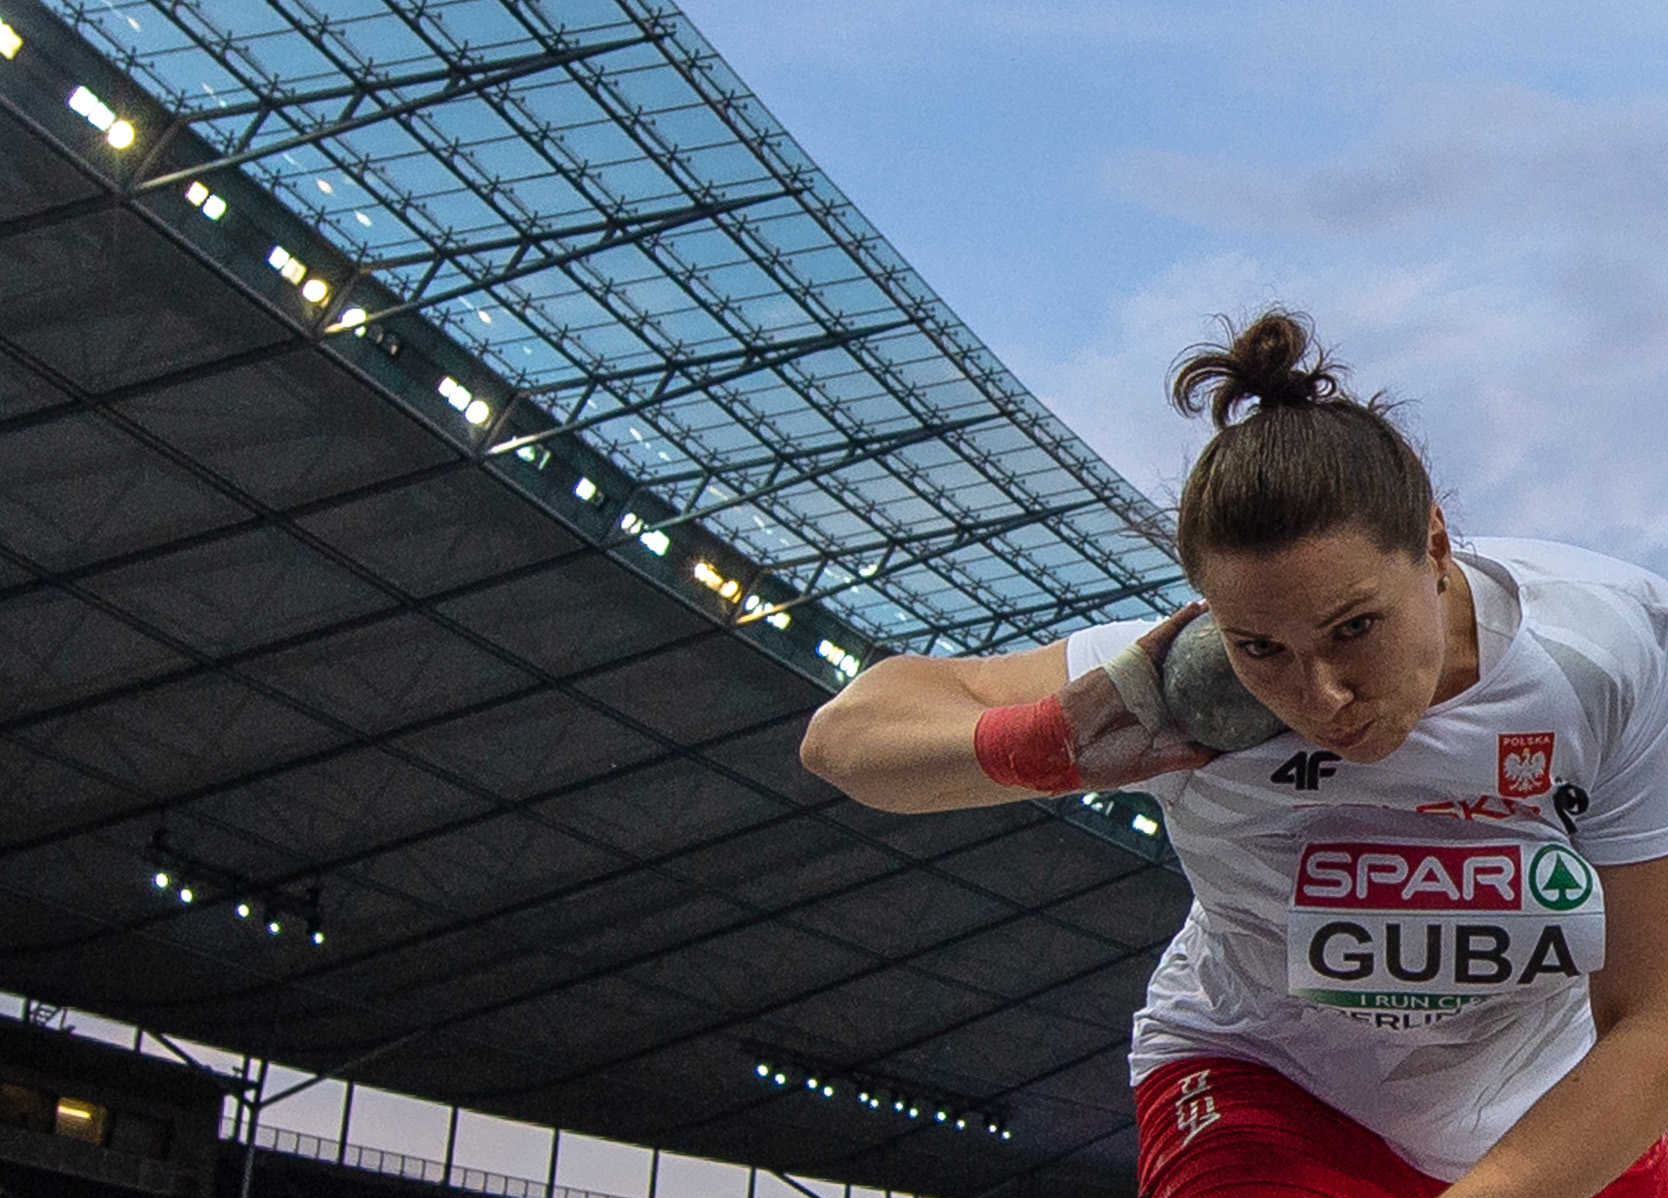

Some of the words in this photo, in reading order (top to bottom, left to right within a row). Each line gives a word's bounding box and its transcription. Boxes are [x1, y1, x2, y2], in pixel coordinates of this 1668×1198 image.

[1503, 736, 1551, 747] POLSKA
[1270, 751, 1343, 790] 4F
[1303, 852, 1515, 900] SPAR
[1309, 922, 1581, 985] GUBA
[1360, 994, 1367, 1006] I
[1375, 995, 1429, 1008] RUN
